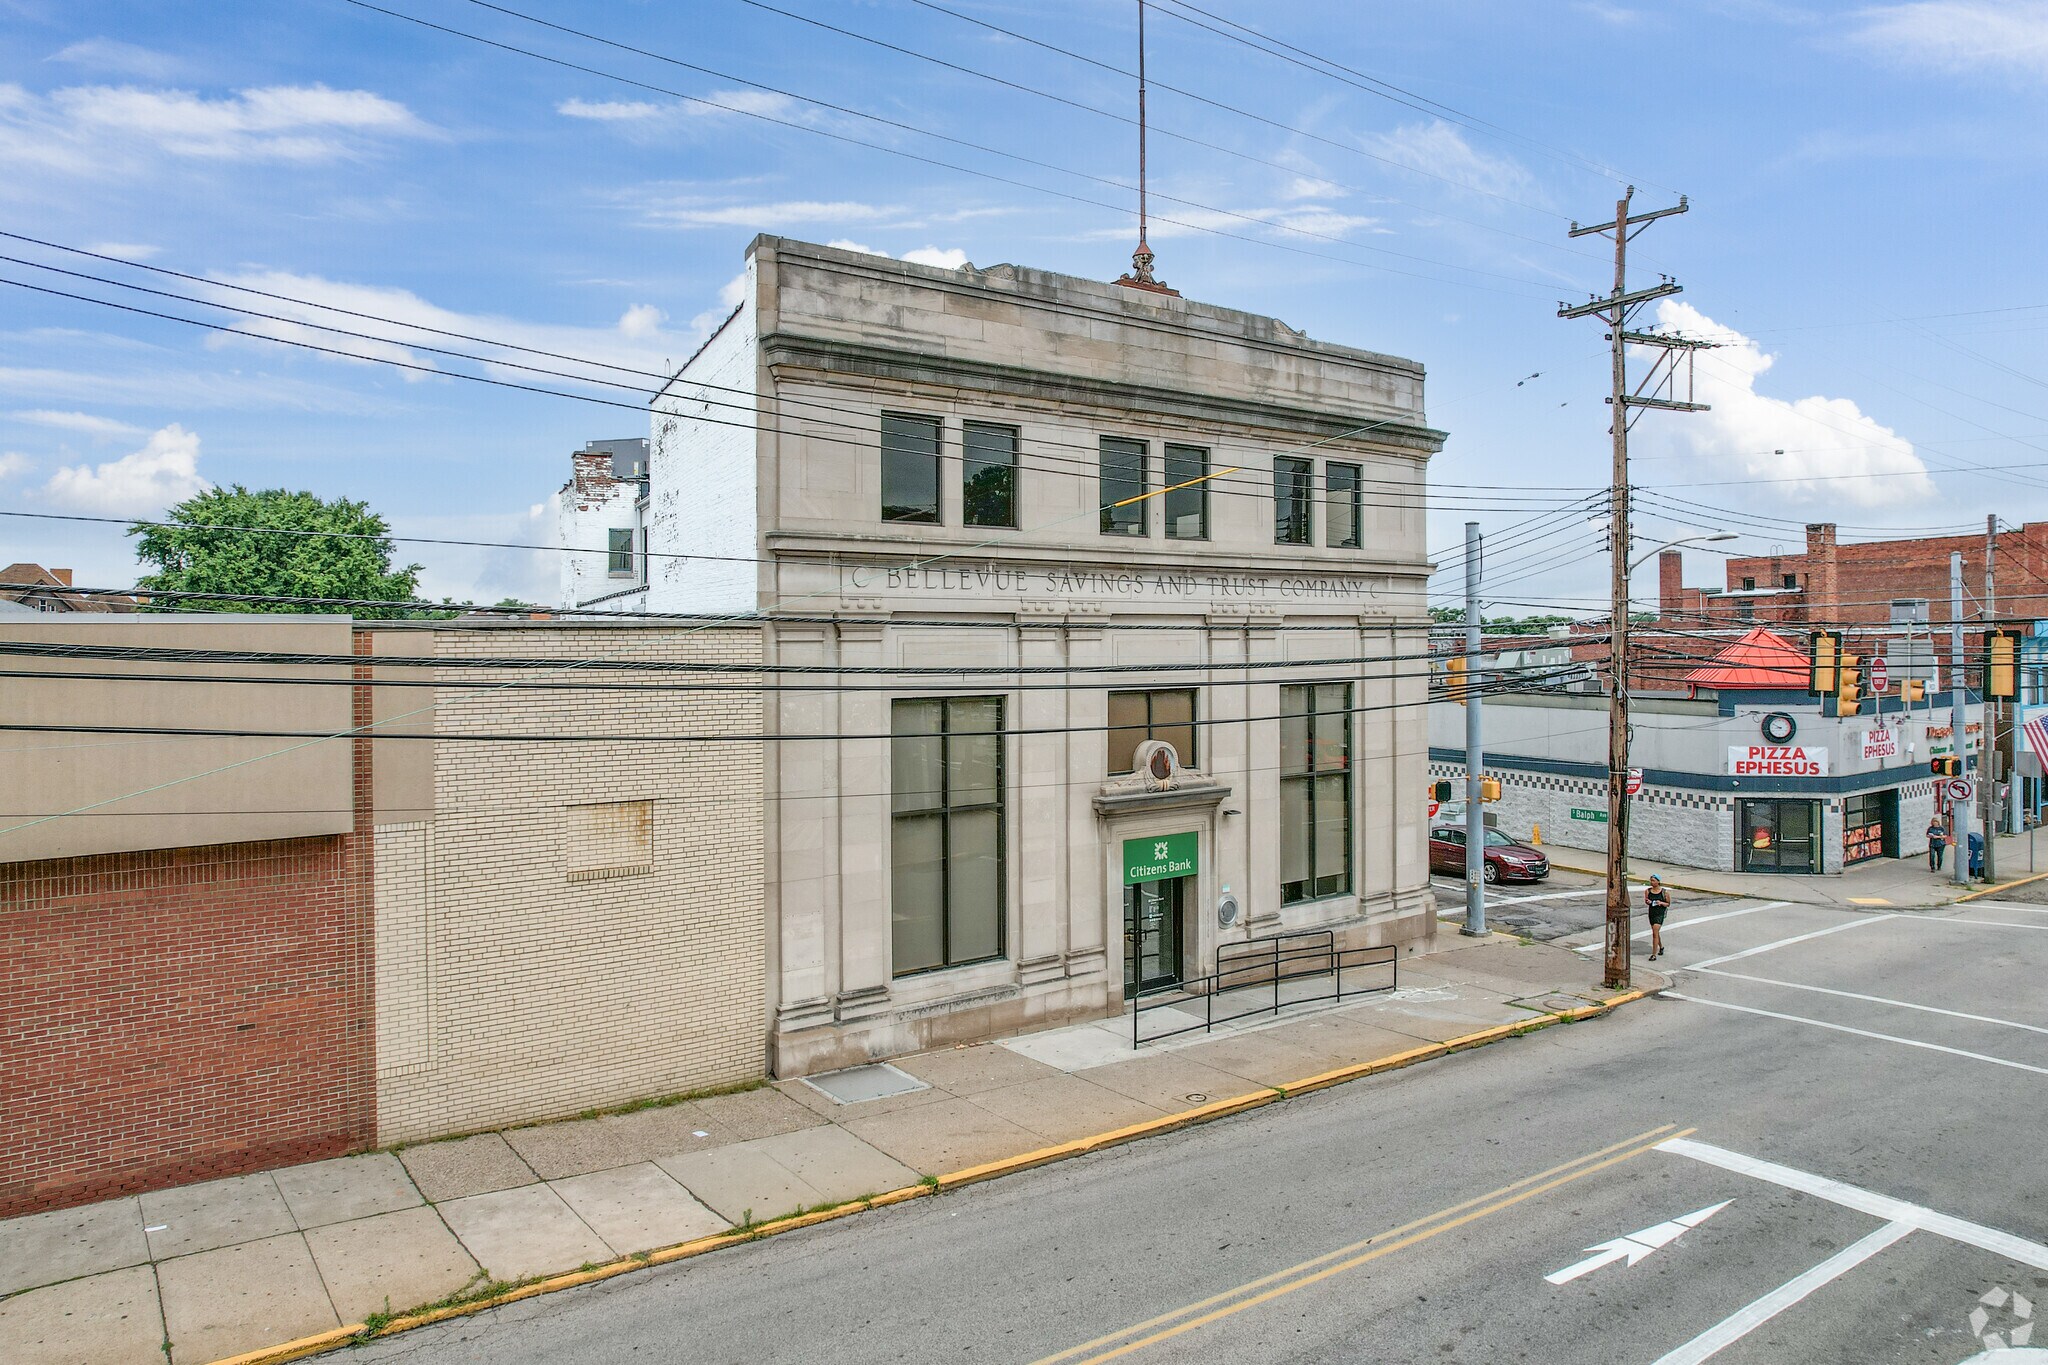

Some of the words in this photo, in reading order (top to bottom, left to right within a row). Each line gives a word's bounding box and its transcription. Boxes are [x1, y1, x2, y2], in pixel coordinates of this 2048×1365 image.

[887, 568, 1028, 592] BELLEVUE
[1046, 572, 1144, 594] SAVINGS
[1154, 575, 1197, 596] AND
[1206, 577, 1269, 597] TRUST
[1280, 579, 1363, 599] COMPANY
[1869, 729, 1891, 743] PIZZA
[1748, 746, 1807, 760] PIZZA
[1864, 742, 1896, 758] EPHESUS
[1736, 761, 1820, 775] EPHESUS
[1576, 809, 1595, 821] Balph
[1130, 864, 1167, 878] Citizens
[1168, 858, 1191, 872] Bank
